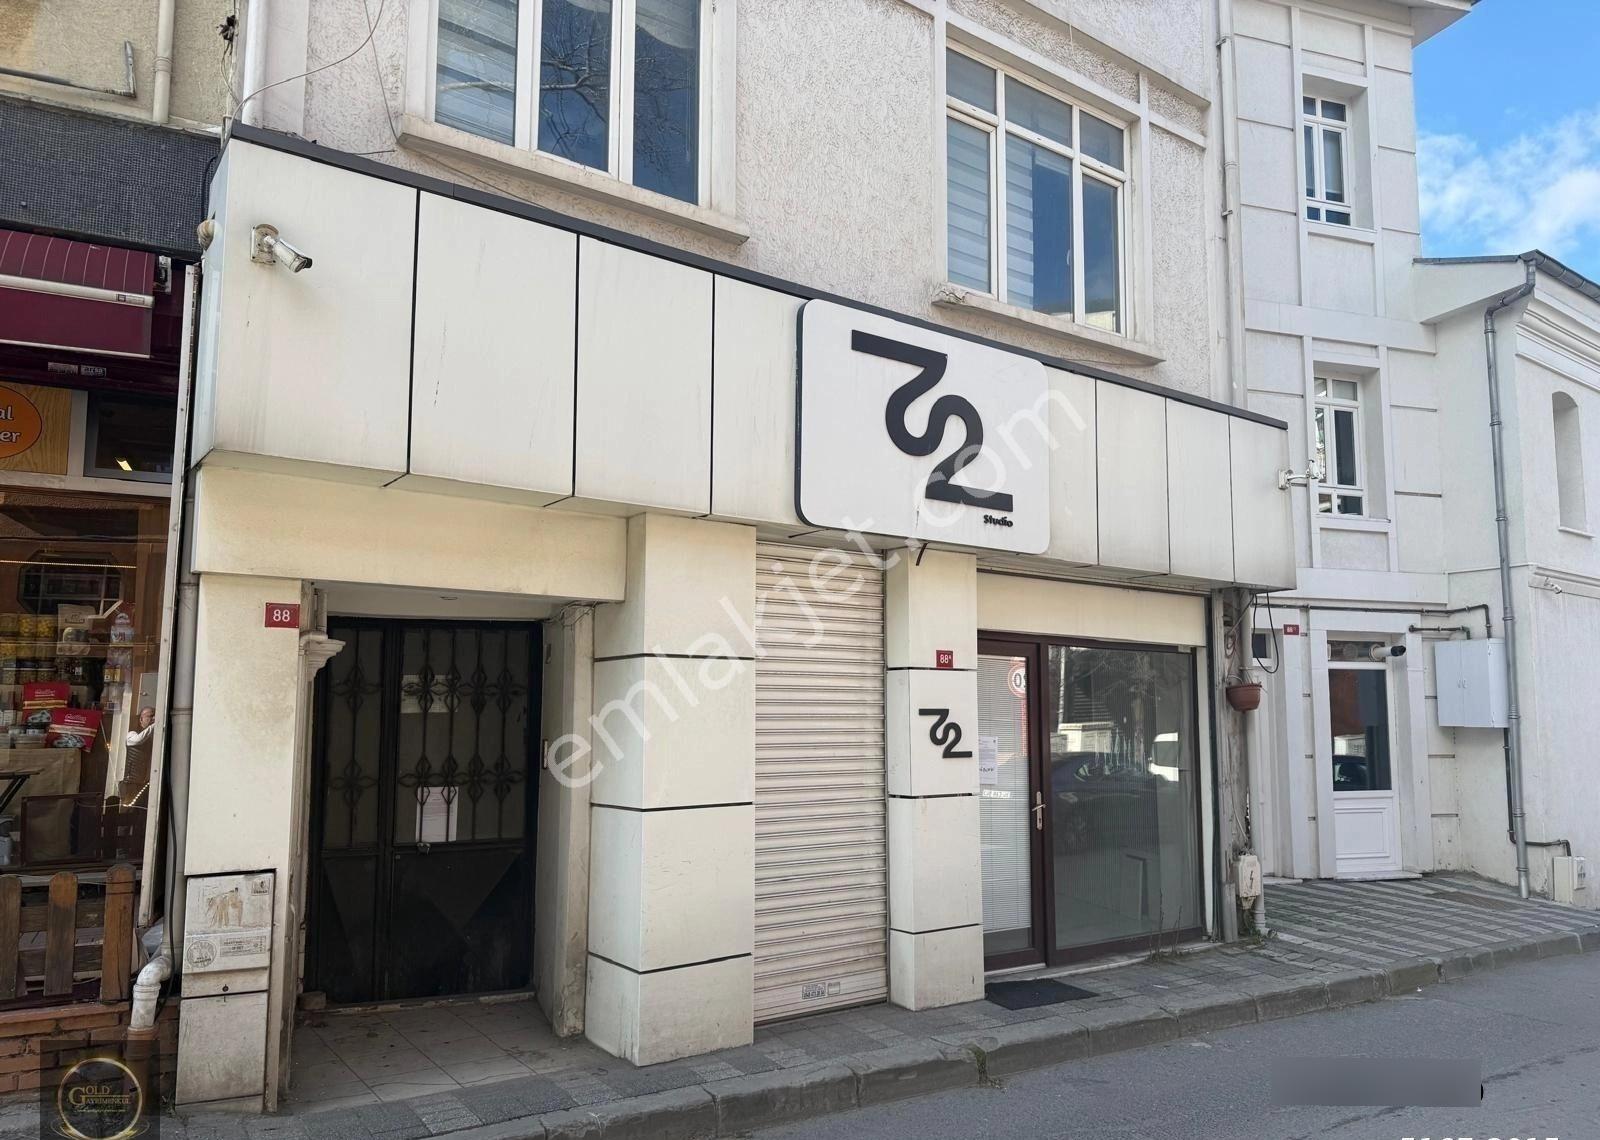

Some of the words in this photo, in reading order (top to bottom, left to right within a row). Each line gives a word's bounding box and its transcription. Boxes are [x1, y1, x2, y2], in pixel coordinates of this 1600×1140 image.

[852, 329, 1013, 512] 72
[983, 514, 1013, 527] Studio
[273, 609, 290, 622] 88
[918, 708, 973, 759] 72
